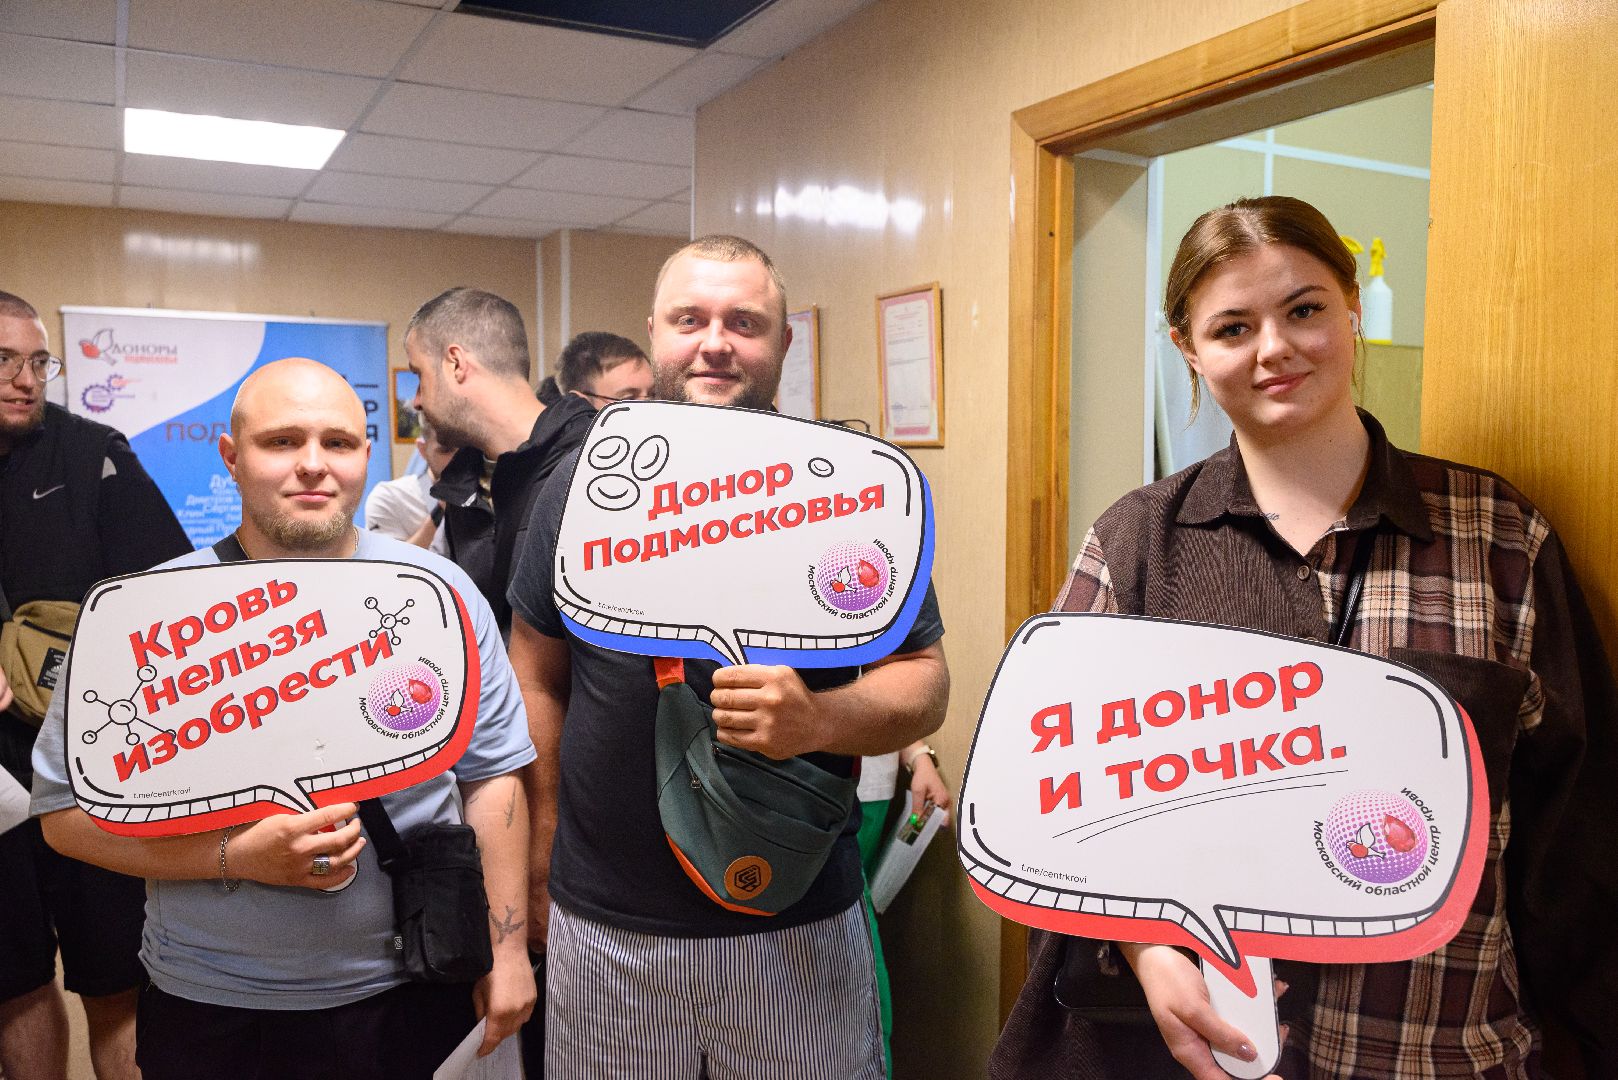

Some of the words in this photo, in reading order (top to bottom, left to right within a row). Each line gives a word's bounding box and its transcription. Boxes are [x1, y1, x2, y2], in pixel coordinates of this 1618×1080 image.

[647, 463, 794, 523] Донор
[583, 484, 886, 573] Подмосковья
[873, 538, 895, 565] крови
[807, 564, 838, 617] Московский
[886, 566, 898, 598] центр
[128, 579, 300, 670] Кровь
[840, 596, 889, 620] областной
[141, 610, 328, 717] нельзя
[418, 656, 443, 677] крови
[112, 631, 394, 784] изобрести
[440, 678, 449, 708] центр
[1030, 703, 1075, 753] Я
[1096, 662, 1323, 746] донор
[359, 696, 400, 740] Московский
[401, 708, 446, 740] областной
[1039, 772, 1082, 816] и
[1105, 725, 1347, 801] точка.
[1400, 787, 1435, 822] крови
[1313, 819, 1362, 891] Московский
[1428, 825, 1441, 866] центр
[1021, 863, 1088, 884] t.me/centrkrovi
[1364, 864, 1432, 897] областной
